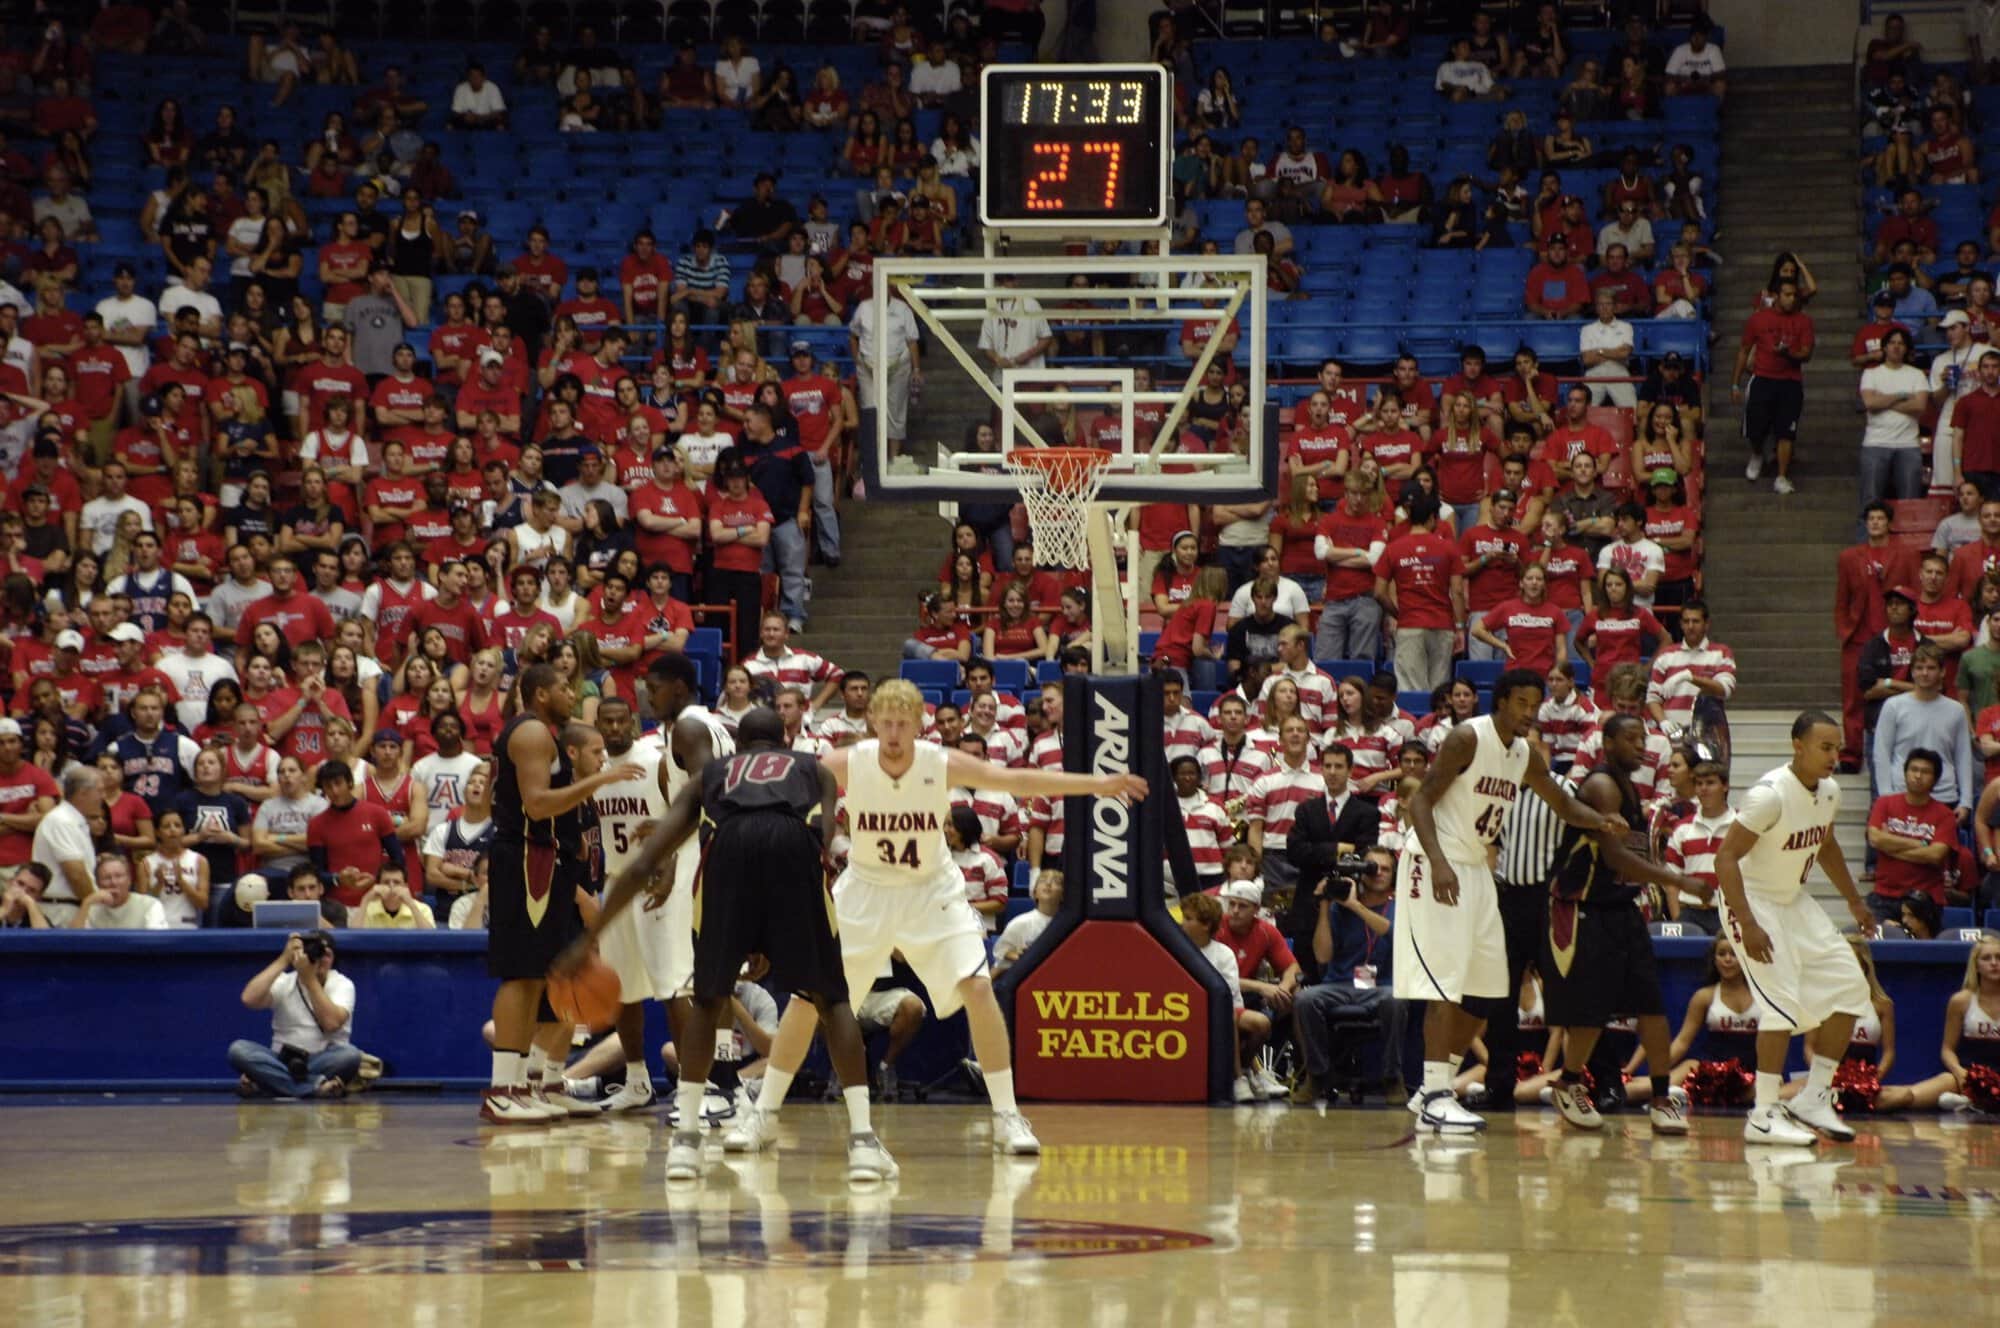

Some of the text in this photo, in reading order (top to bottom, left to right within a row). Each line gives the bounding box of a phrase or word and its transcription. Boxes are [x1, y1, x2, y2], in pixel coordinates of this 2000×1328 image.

[1021, 82, 1142, 124] 17:33
[1026, 141, 1121, 209] 27
[428, 773, 463, 808] A
[724, 751, 795, 795] 10
[613, 822, 629, 854] 5
[857, 812, 938, 832] ARIZONA
[1475, 803, 1505, 838] 43
[876, 838, 921, 869] 34
[1410, 854, 1425, 899] CATS
[1032, 990, 1191, 1022] WELLS
[1036, 1028, 1188, 1060] FARGO
